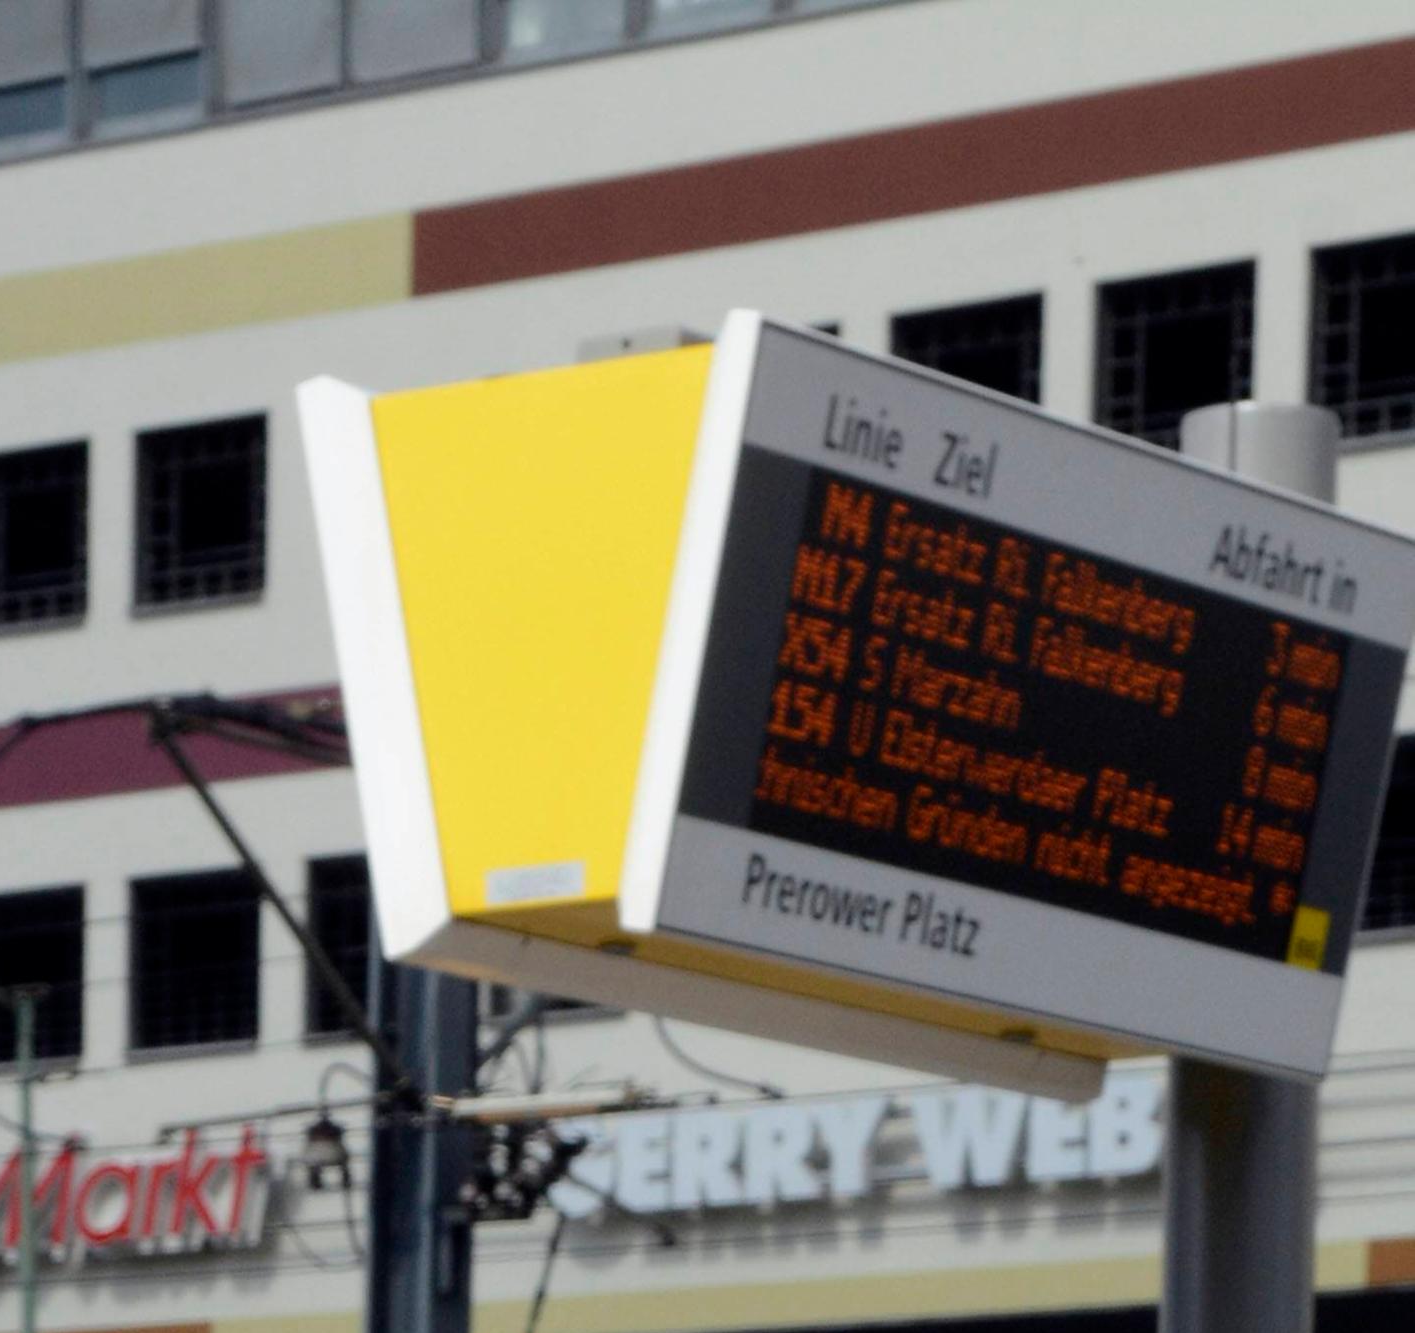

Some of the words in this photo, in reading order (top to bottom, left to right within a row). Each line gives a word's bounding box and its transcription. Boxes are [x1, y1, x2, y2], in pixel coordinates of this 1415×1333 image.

[824, 394, 904, 470] Linie
[934, 429, 1000, 498] Ziel
[821, 483, 872, 547] M4
[884, 502, 985, 583] Ersatz
[1208, 523, 1325, 604] Abfahrt
[1327, 557, 1358, 615] in
[791, 545, 866, 612] M17
[872, 569, 973, 648] Ersatz
[778, 612, 850, 679] X54
[859, 635, 887, 689] S
[768, 680, 836, 744] 154
[850, 703, 873, 755] U
[1217, 806, 1251, 852] 14
[742, 852, 893, 934] Prerower
[898, 890, 981, 957] Platz
